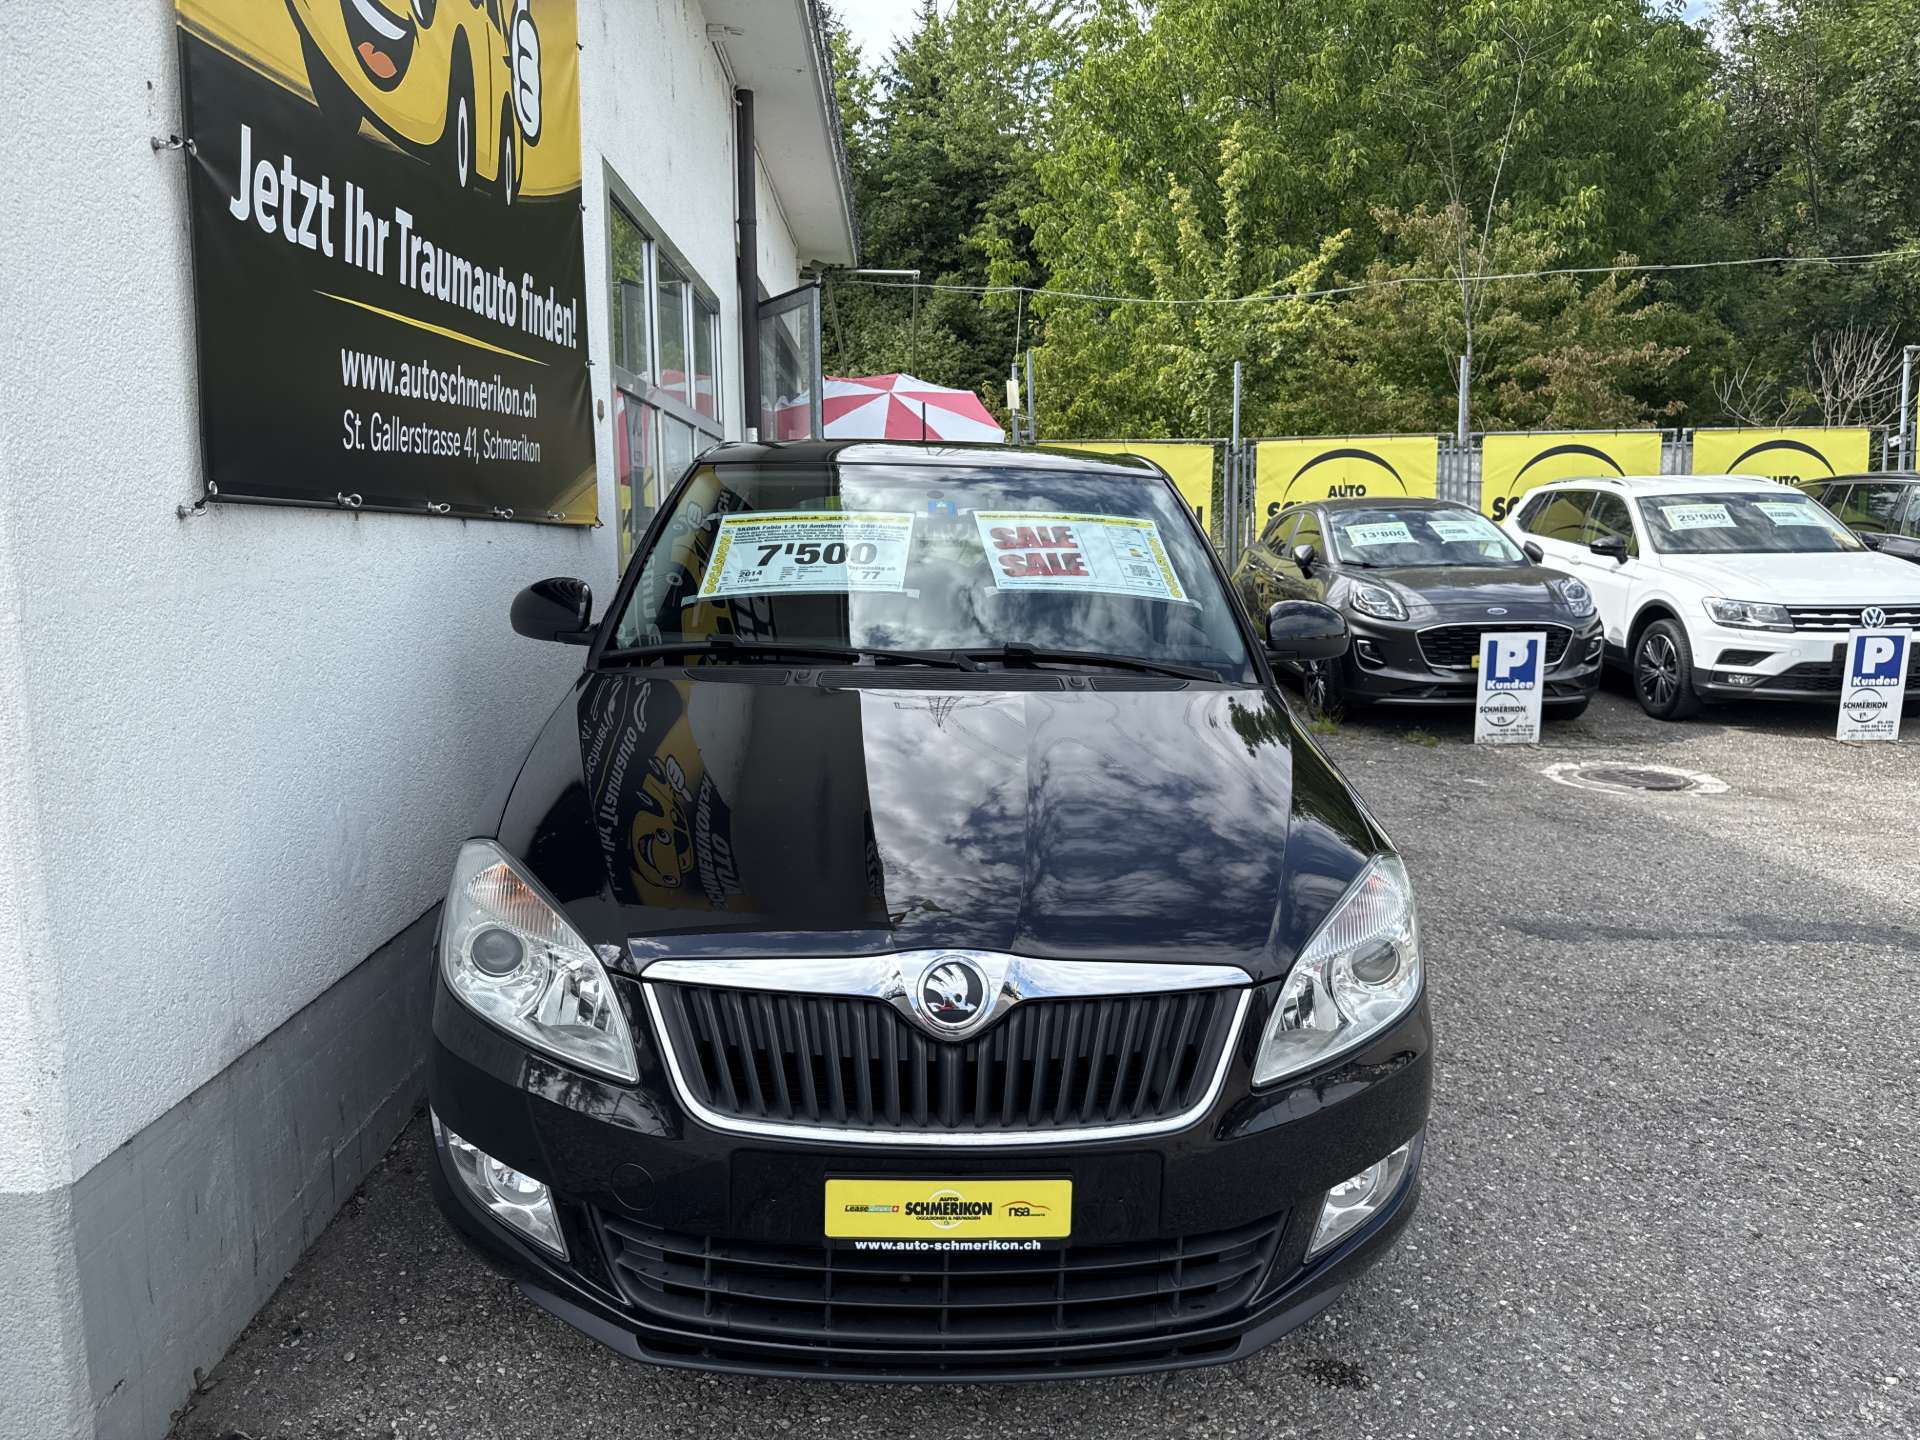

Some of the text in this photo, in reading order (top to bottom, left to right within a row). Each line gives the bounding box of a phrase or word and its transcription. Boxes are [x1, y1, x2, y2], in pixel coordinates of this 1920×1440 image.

[229, 123, 577, 350] Jetzt Ihr Traumauto finden!
[341, 347, 538, 419] www.autoschmerikon.ch
[342, 409, 541, 464] St. Gallerstrasse 41, Schmerikon
[1766, 475, 1800, 487] UTO
[1328, 485, 1366, 498] AUTO
[990, 526, 1078, 550] SALE
[1360, 529, 1406, 540] 13'800
[757, 542, 878, 567] 7'500
[999, 552, 1089, 577] SALE
[738, 569, 763, 578] 2014
[862, 570, 881, 580] 77
[1495, 639, 1529, 678] P
[1862, 637, 1895, 674] P
[1487, 679, 1534, 690] Kunden
[1853, 676, 1898, 686] Kunden
[1480, 705, 1527, 714] SCHMERIKON
[905, 1202, 992, 1216] SCHMERIKON
[1009, 1207, 1030, 1217] nsa
[855, 1240, 1041, 1251] www.auto-schmerikon.ch
